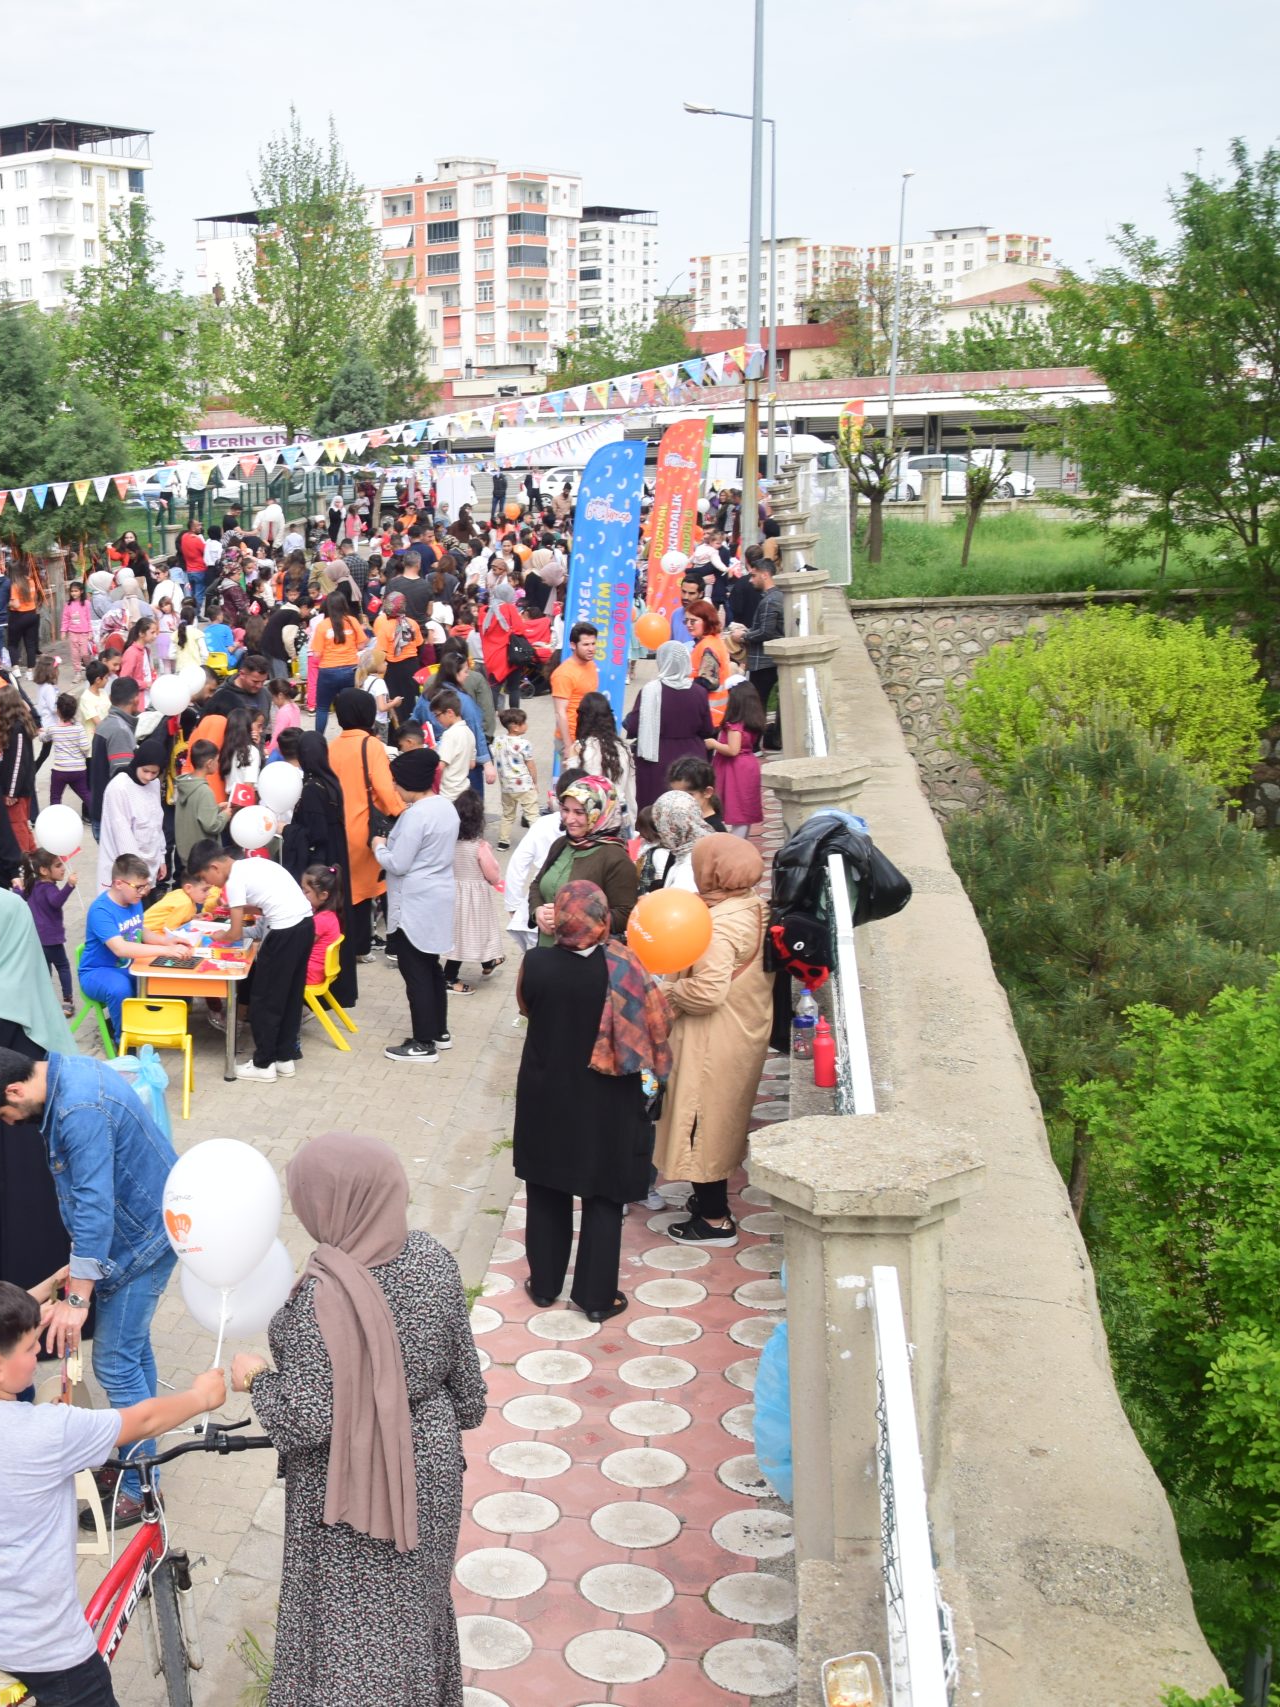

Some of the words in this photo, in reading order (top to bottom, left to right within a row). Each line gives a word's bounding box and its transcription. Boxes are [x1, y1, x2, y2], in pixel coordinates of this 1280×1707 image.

[668, 494, 682, 552] KINDALIK
[576, 577, 592, 622] NSEL
[612, 582, 631, 665] MODÜLÜ
